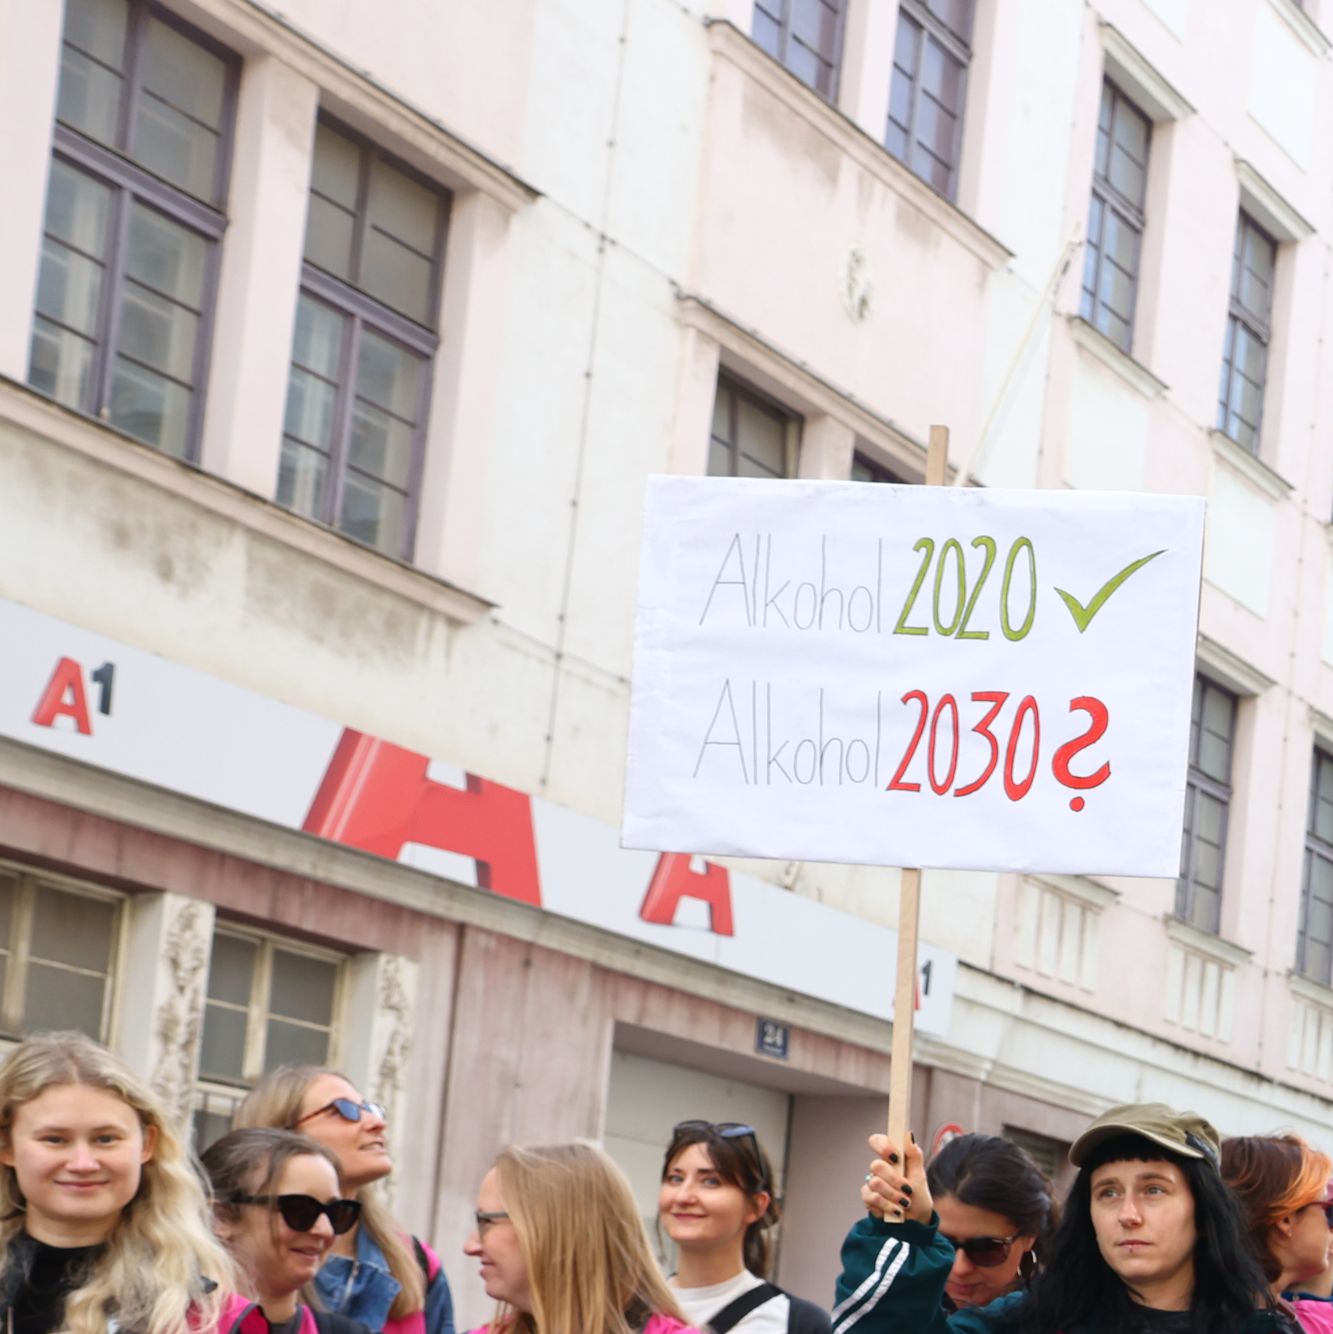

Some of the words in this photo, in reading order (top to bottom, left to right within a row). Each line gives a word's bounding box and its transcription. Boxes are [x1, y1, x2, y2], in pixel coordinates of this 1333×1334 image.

[699, 533, 882, 633] Alkohol
[893, 536, 1037, 641] 2020
[31, 656, 116, 736] A1
[693, 678, 882, 788] Alkohol
